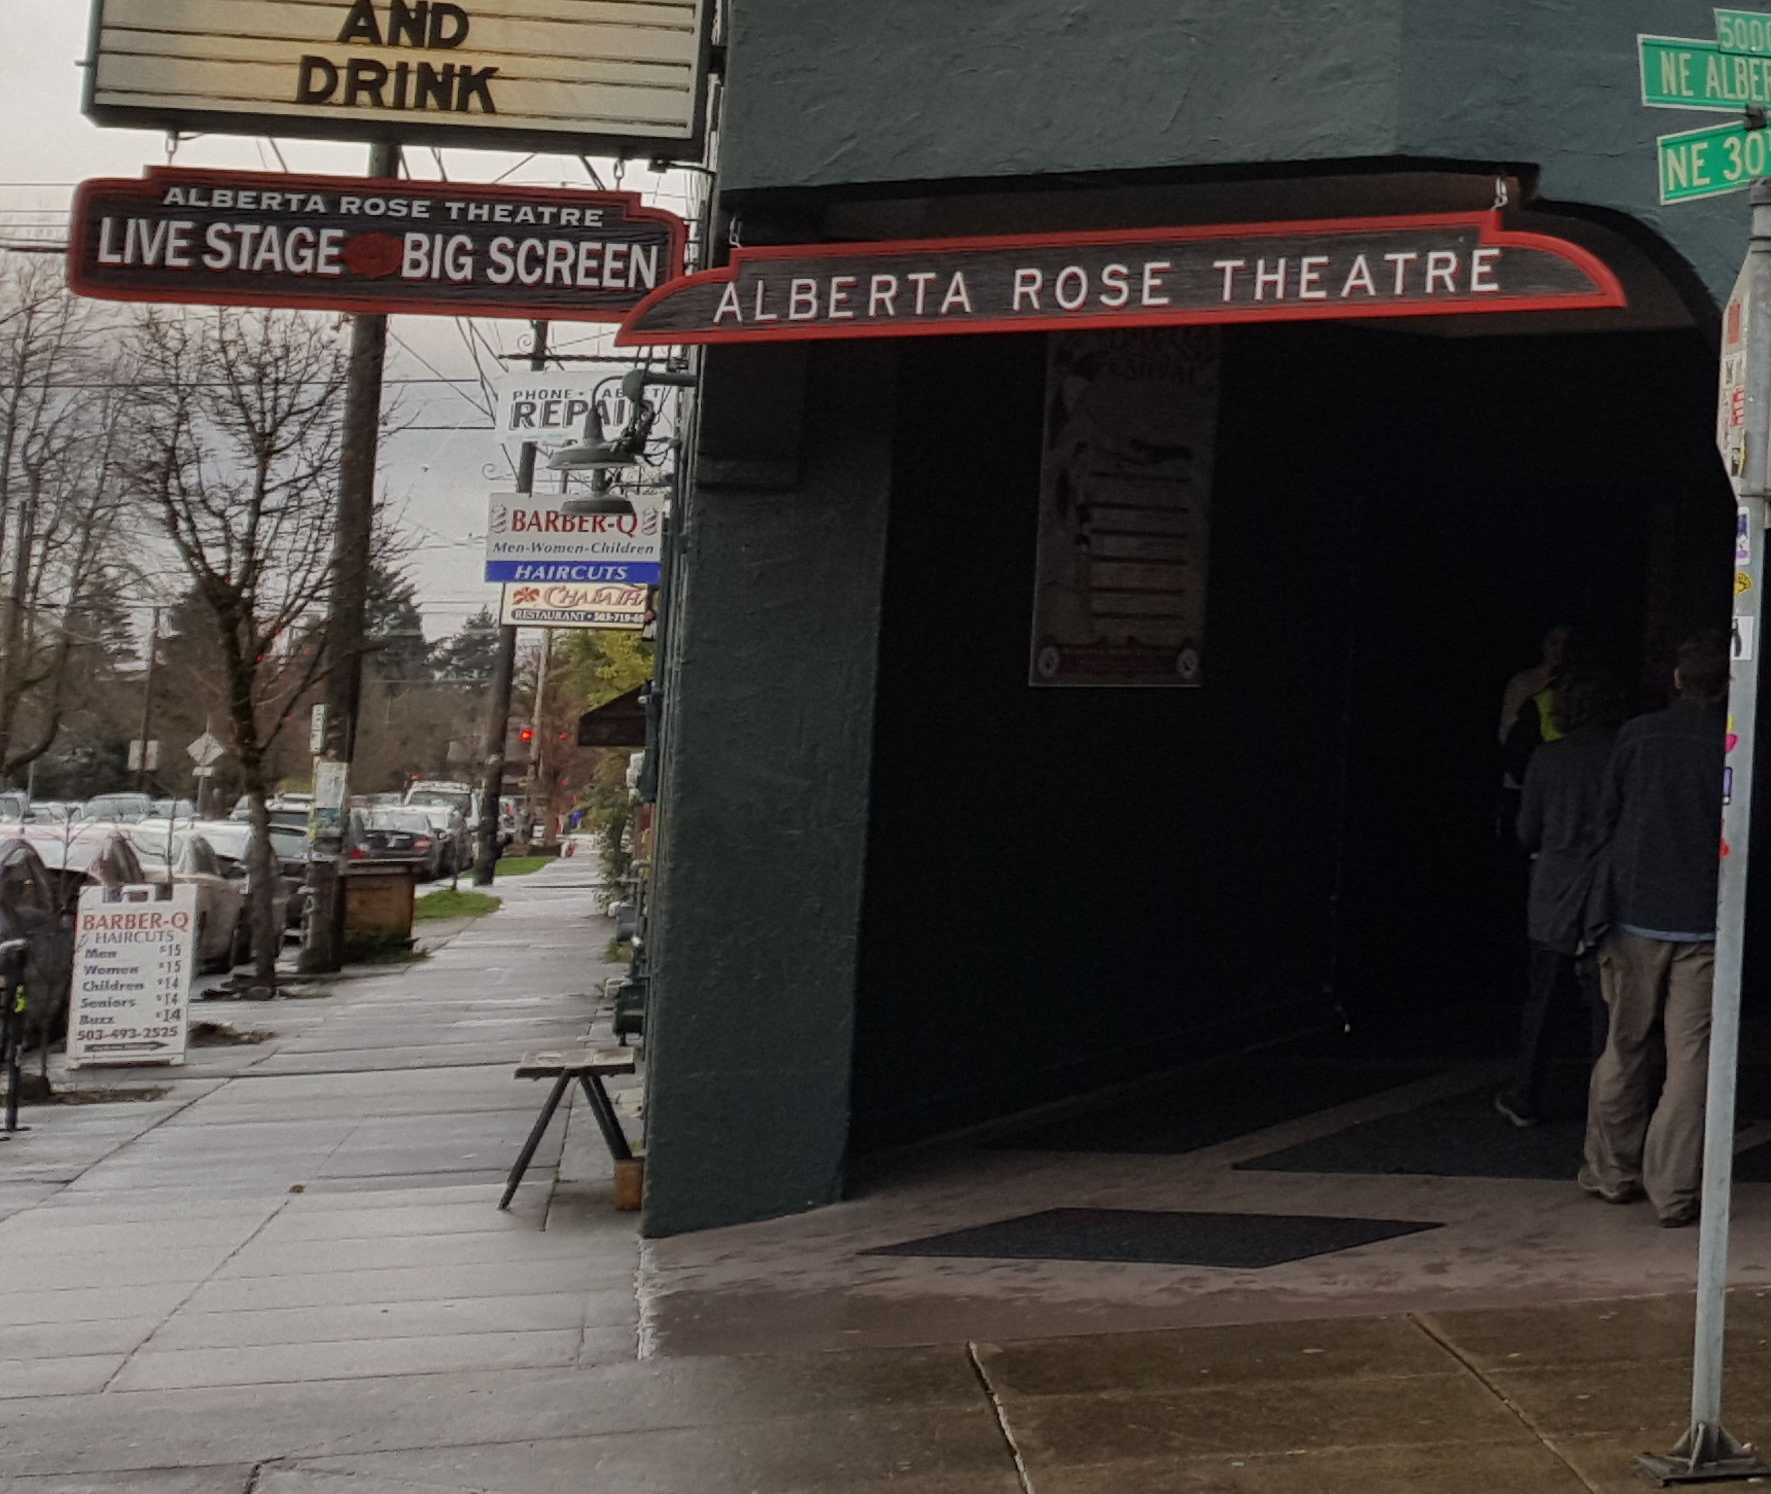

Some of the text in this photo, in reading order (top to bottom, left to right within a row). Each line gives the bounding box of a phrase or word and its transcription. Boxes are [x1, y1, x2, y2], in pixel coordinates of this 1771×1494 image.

[1660, 51, 1694, 96] NE
[295, 55, 500, 113] DRINK
[1666, 142, 1710, 191] NE
[163, 187, 604, 227] ALBERTA ROSE THEATRE
[98, 216, 658, 291] LIVE STAGE BIG SCREEN
[713, 248, 1502, 325] ALBERTA ROSE THEATRE
[513, 389, 572, 400] PHONE
[511, 509, 637, 538] BARBER-Q
[514, 564, 628, 580] HAIRCUTS
[515, 609, 585, 622] RESTAURANT
[83, 912, 189, 932] BARBER-Q
[95, 930, 174, 944] HAIRCUTS
[84, 965, 138, 975] Women
[82, 981, 144, 992] Children
[81, 997, 136, 1008] Seniors
